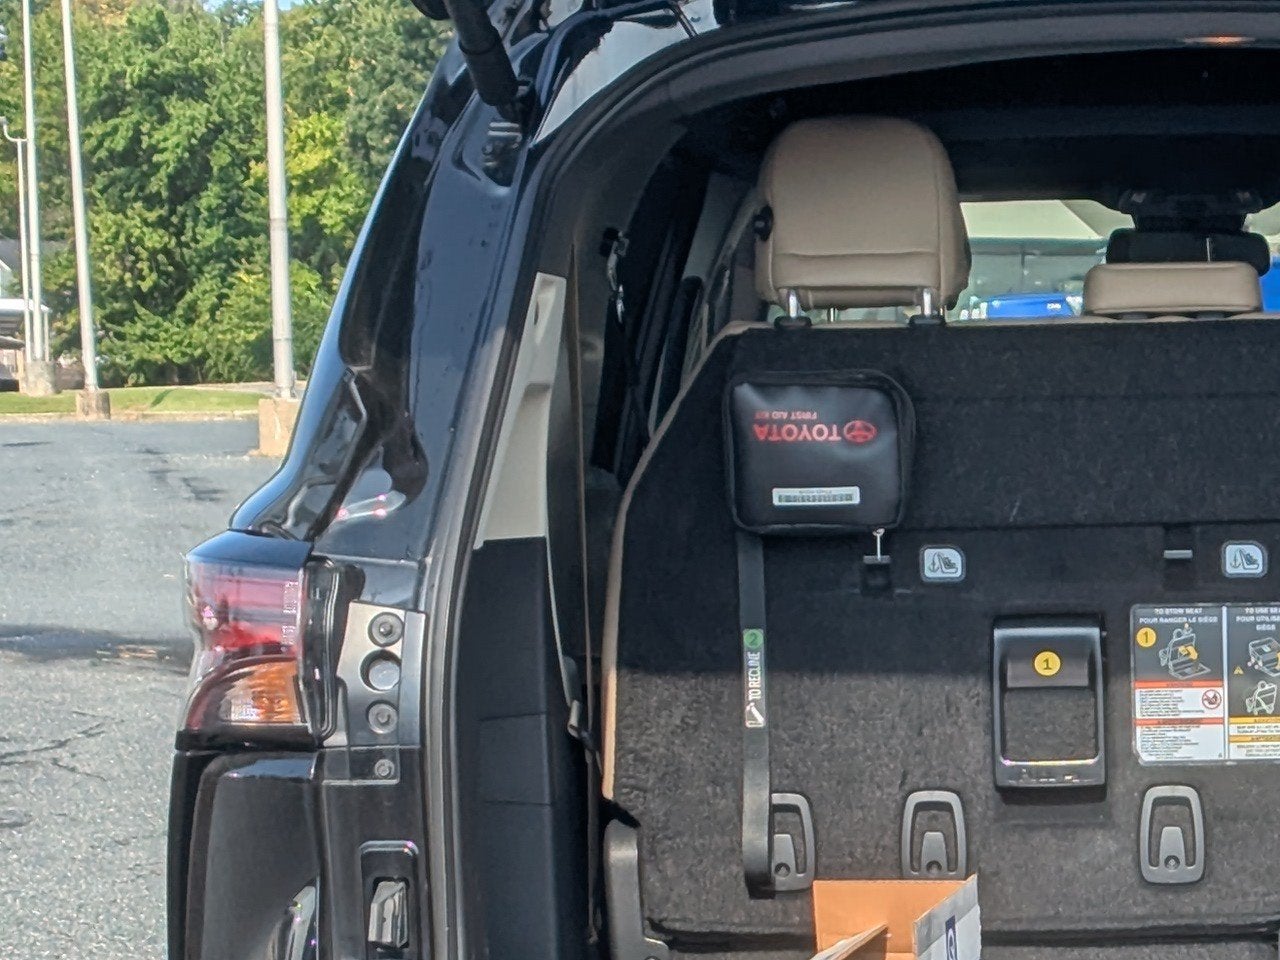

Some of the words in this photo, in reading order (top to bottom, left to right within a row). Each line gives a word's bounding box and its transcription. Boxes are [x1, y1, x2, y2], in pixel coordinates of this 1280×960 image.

[771, 411, 788, 420] AID
[790, 411, 818, 420] FIRST
[753, 423, 842, 441] TOYOTA
[1042, 658, 1052, 671] 1
